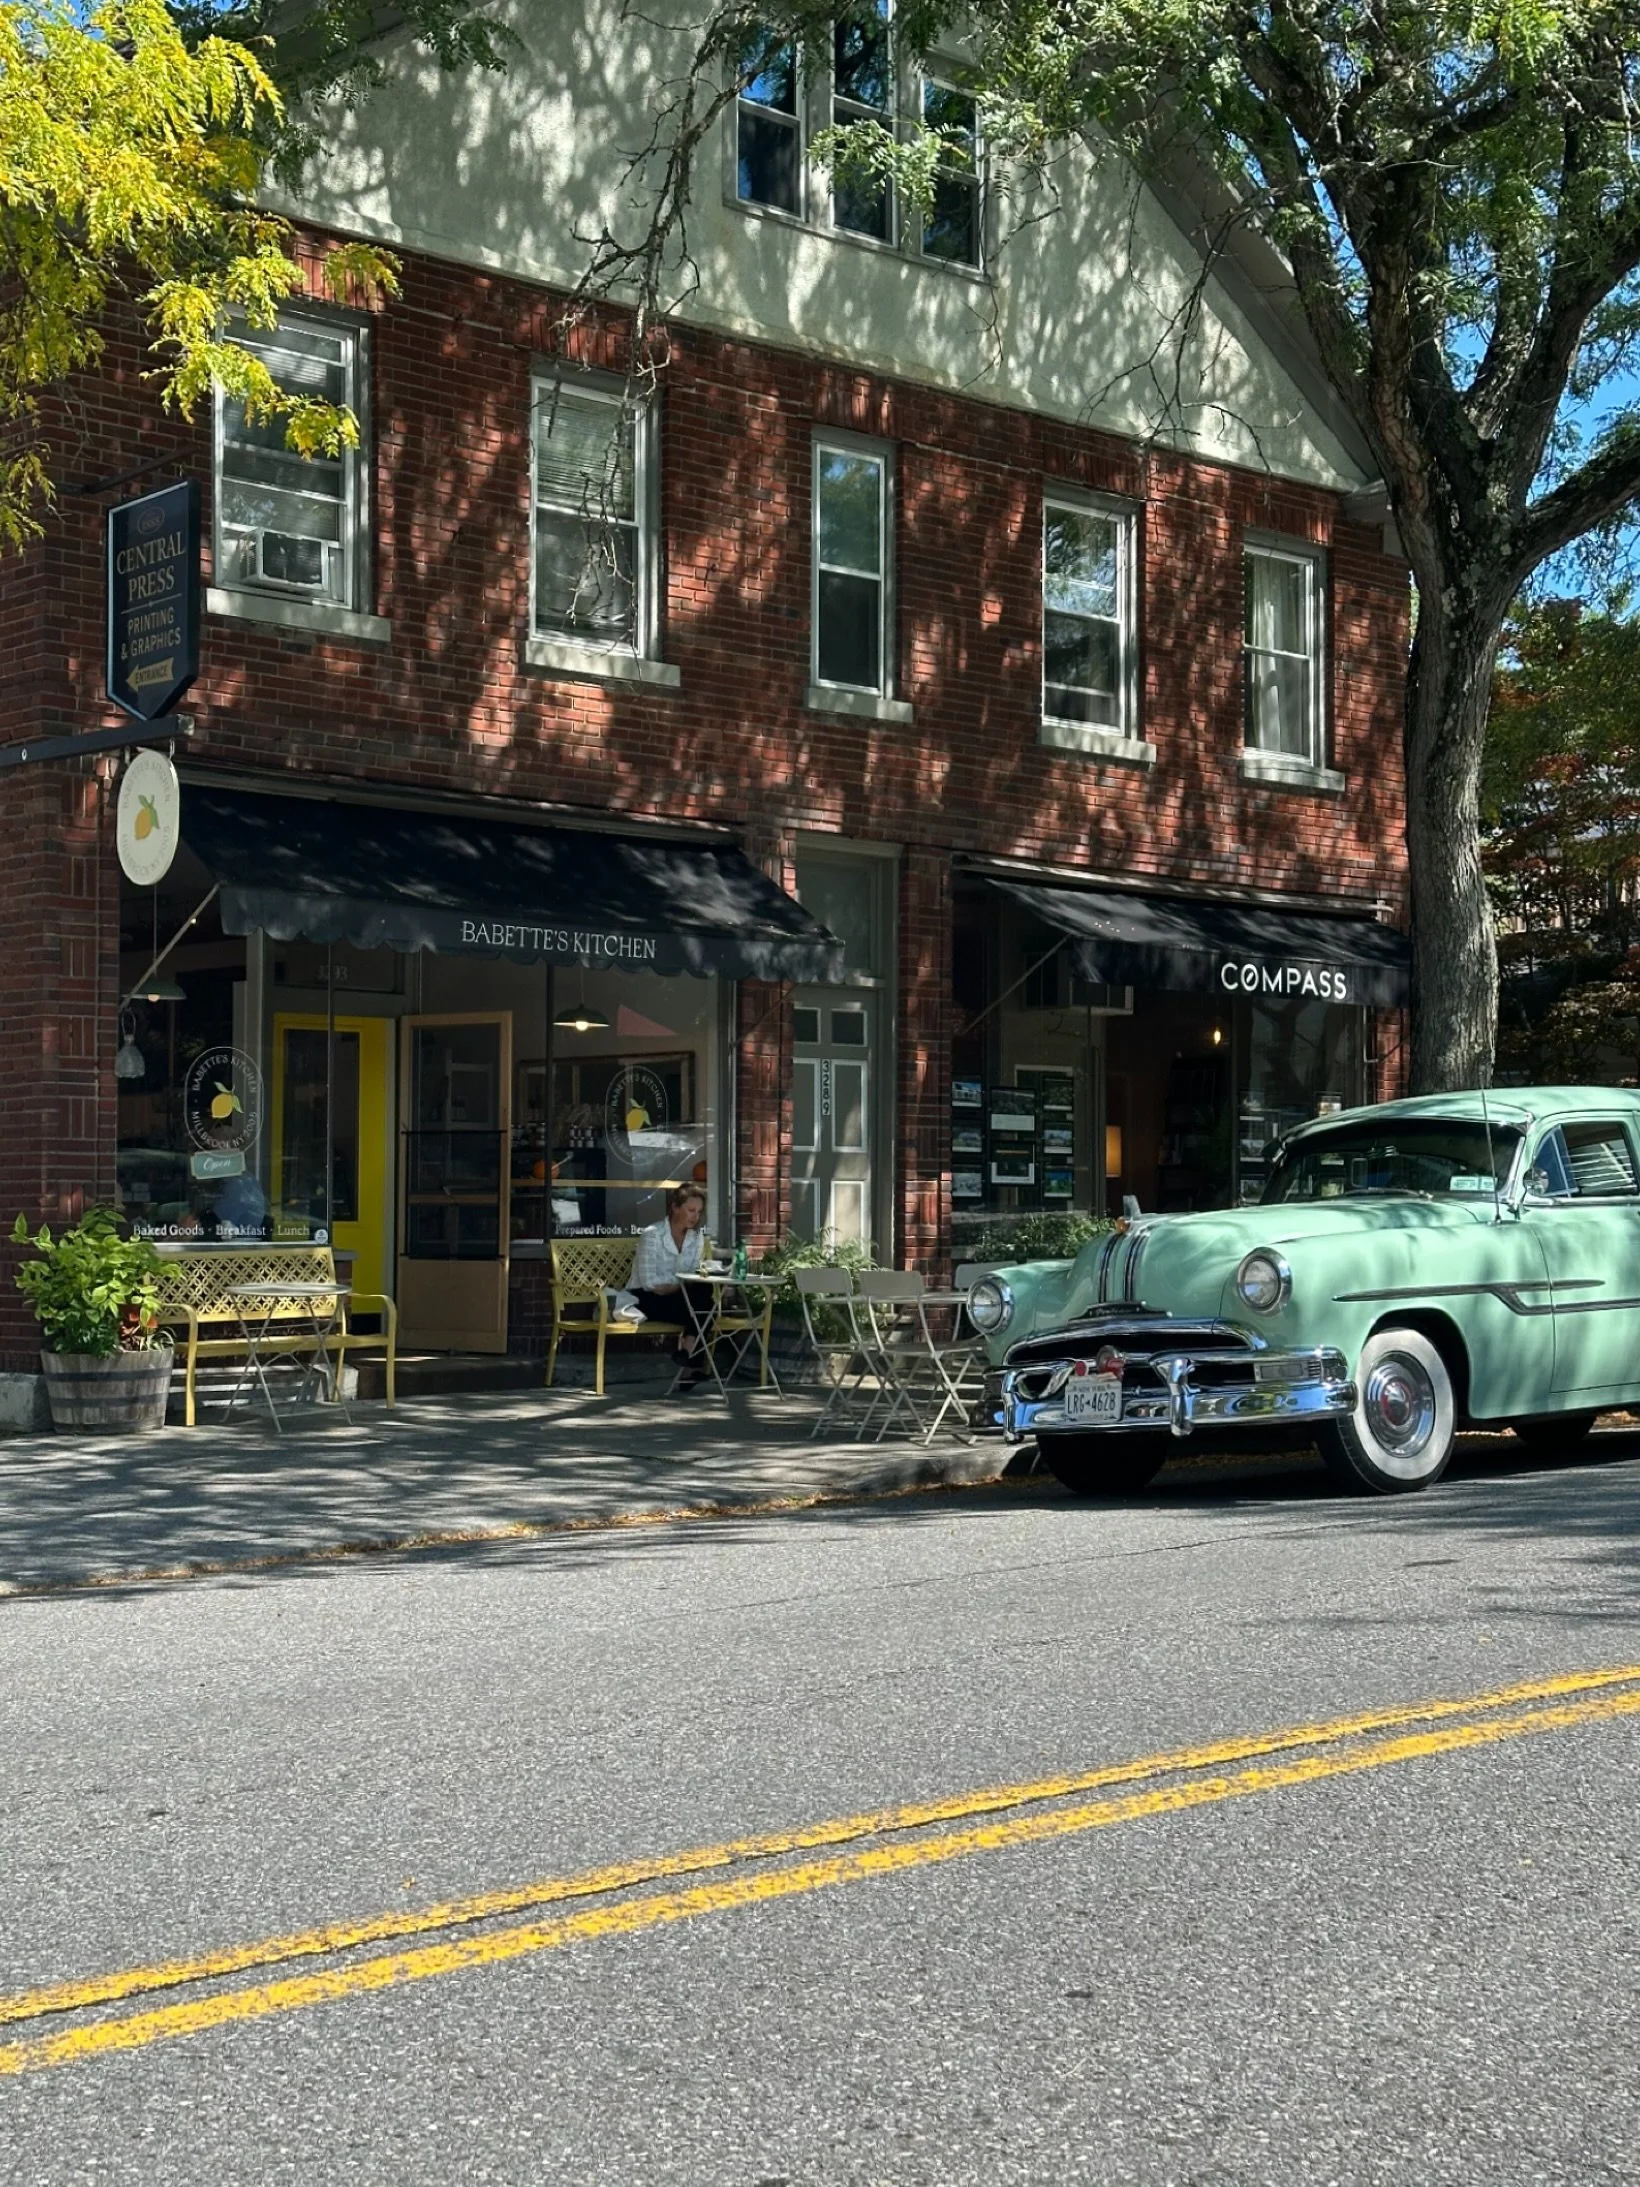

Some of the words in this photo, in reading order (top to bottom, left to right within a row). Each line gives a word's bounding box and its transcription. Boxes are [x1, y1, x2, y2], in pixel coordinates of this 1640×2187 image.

[116, 531, 186, 575] CENTRAL
[128, 565, 175, 601] PRESS
[128, 607, 174, 636] PRINTING
[120, 643, 128, 660] &
[130, 627, 181, 657] GRAPHICS
[462, 920, 569, 951] BABETTE'S
[573, 932, 657, 959] KITCHEN
[1220, 961, 1347, 1000] COMPASS
[192, 1054, 229, 1091] BABETTE'S
[231, 1056, 257, 1093] KITCHEN
[822, 1060, 830, 1115] 3289
[203, 1159, 231, 1171] Open
[133, 1224, 167, 1236] Baked
[169, 1224, 204, 1236] Goods
[215, 1224, 266, 1236] Breakfast
[277, 1224, 310, 1236] Lunch
[555, 1224, 595, 1237] Prepared
[596, 1223, 622, 1235] Foods
